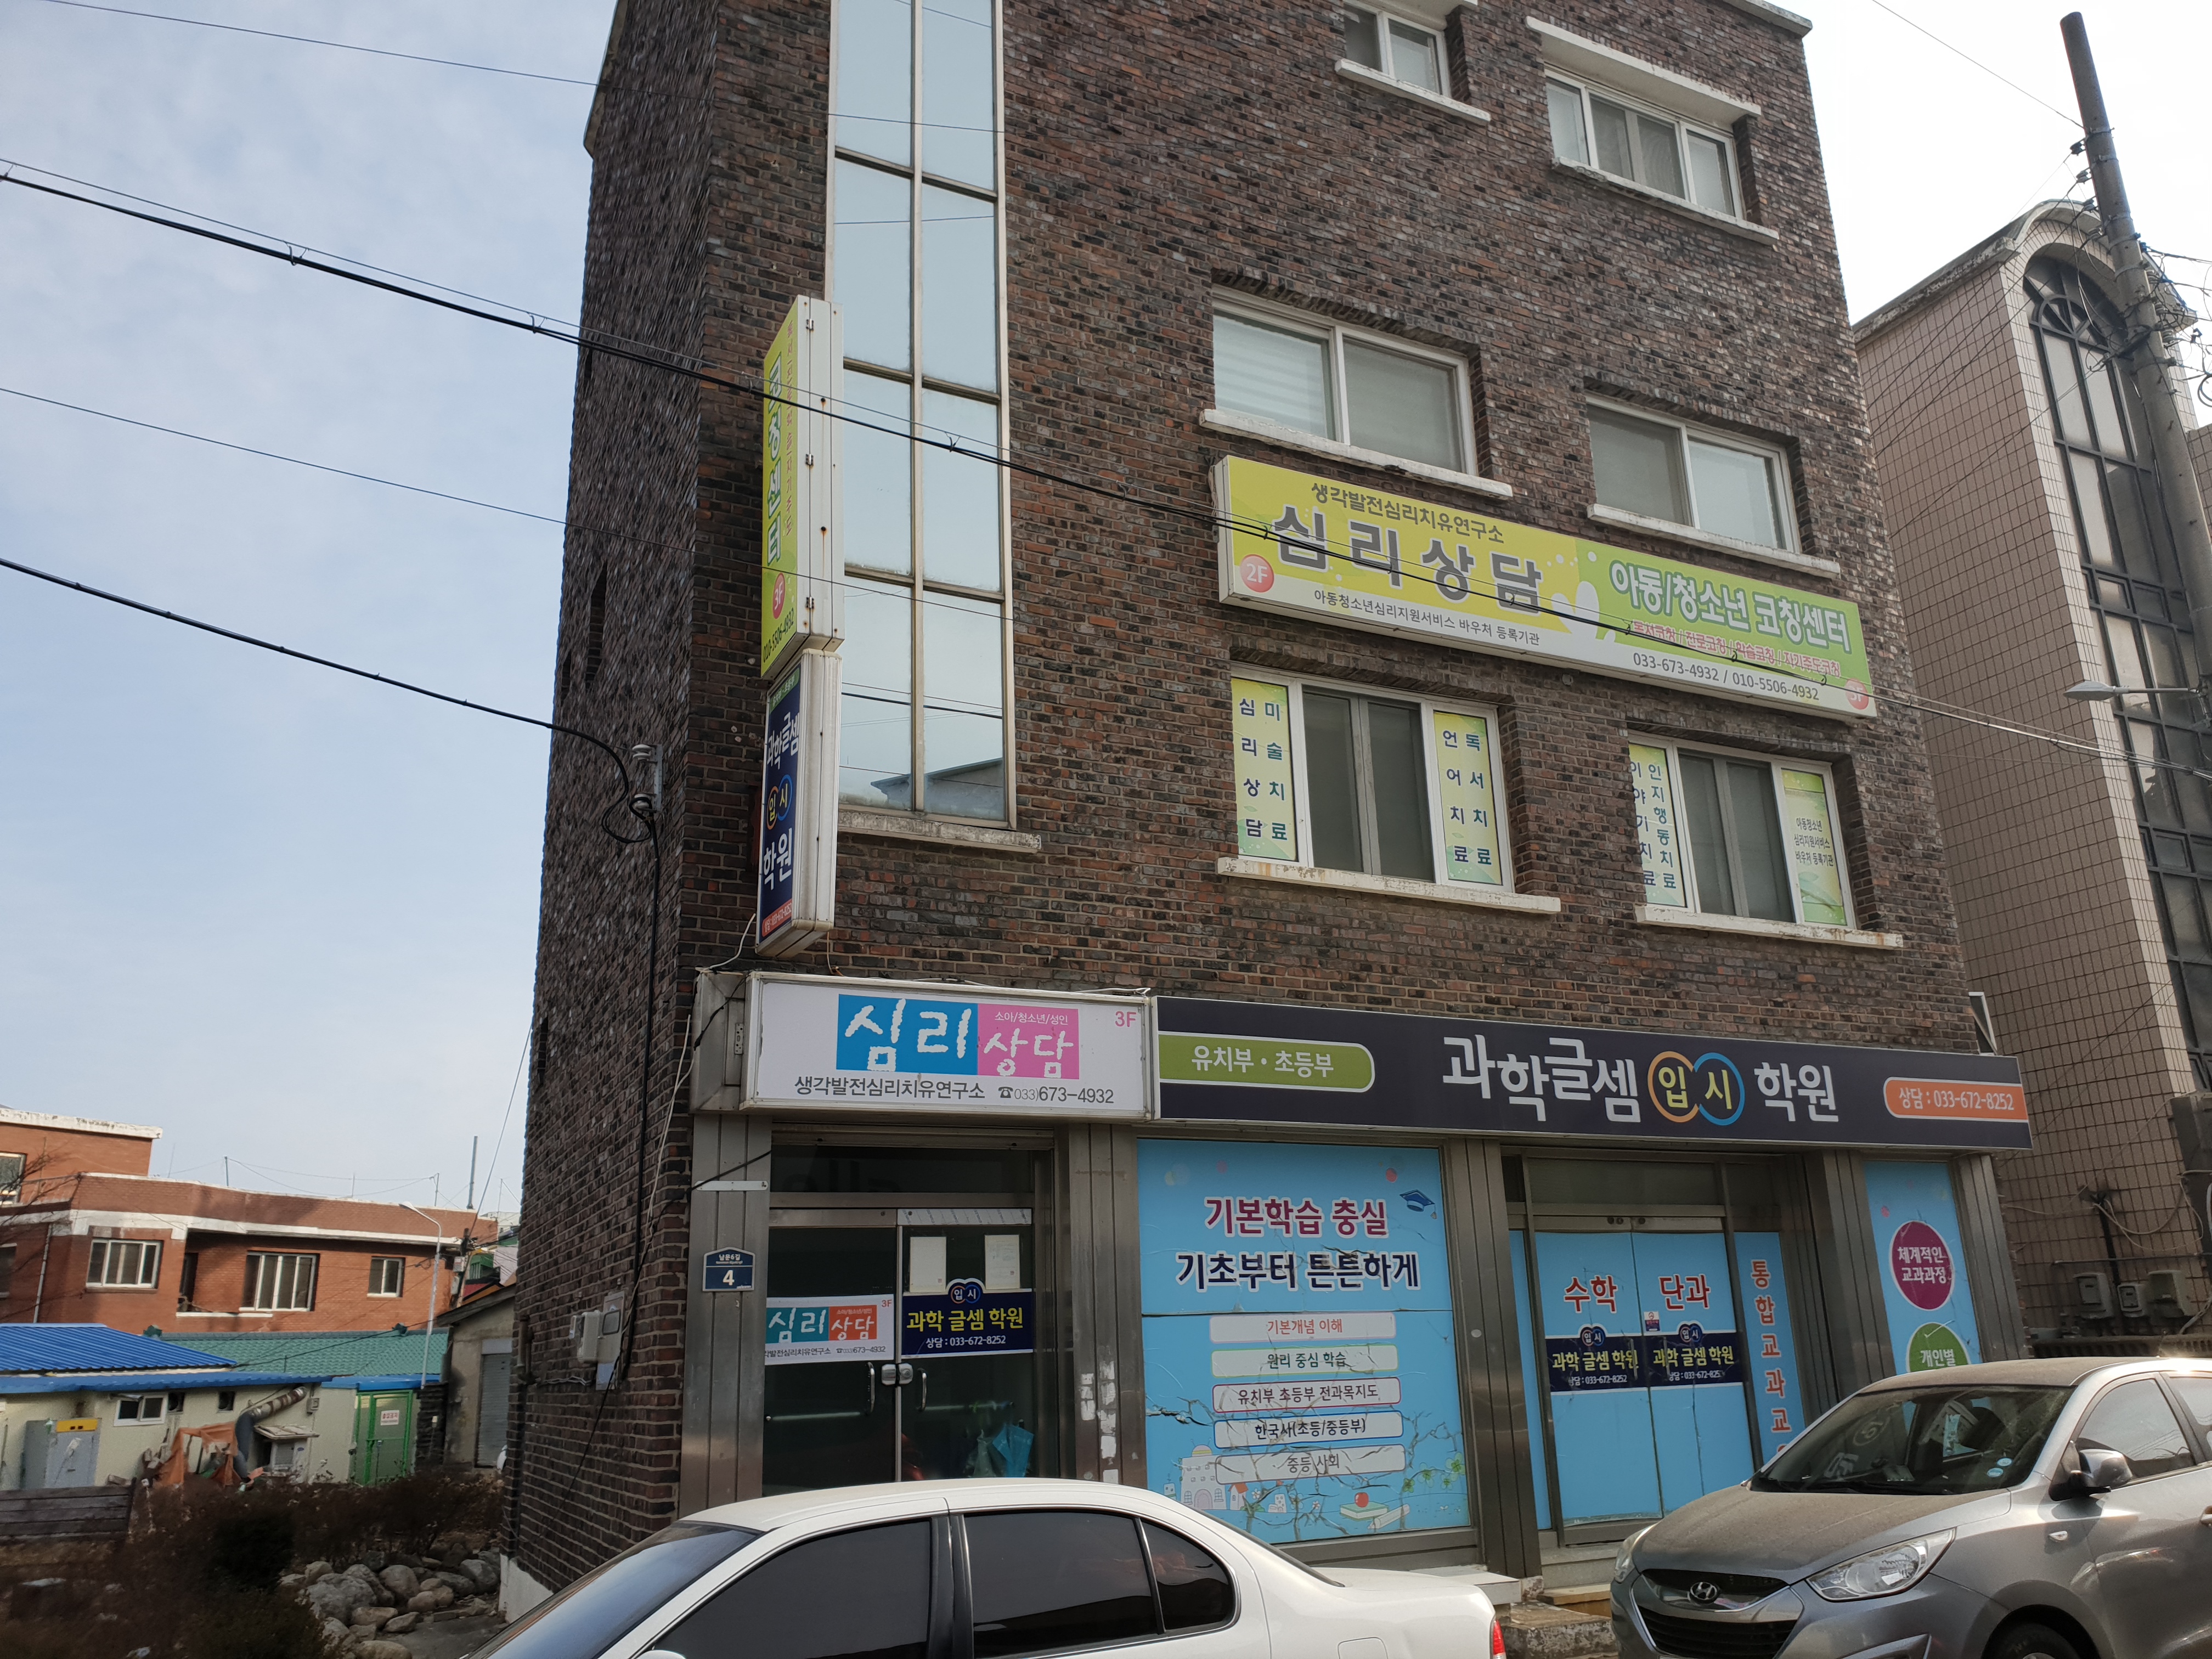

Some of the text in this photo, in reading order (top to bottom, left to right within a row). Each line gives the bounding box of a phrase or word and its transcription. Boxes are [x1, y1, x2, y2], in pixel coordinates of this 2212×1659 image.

[1311, 482, 1504, 544] 생각발전심리치유연구소
[1246, 562, 1268, 584] 2F
[774, 581, 783, 610] 3F
[1610, 561, 1852, 653] 아동/청소년 코칭센터
[1314, 590, 1540, 646] 아동청소년심리지원서비스 바우처 등록기관
[763, 607, 794, 663] 010-5506-4932
[1633, 652, 1719, 681] 033-673-4932
[1733, 673, 1819, 701] 010-5506-4932
[767, 712, 799, 769] 과학글셈
[769, 785, 788, 822] 입시
[763, 827, 792, 891] 학원
[994, 1011, 1069, 1026] 소아/청소년/성인
[1115, 1011, 1137, 1028] 3F
[845, 998, 1073, 1079] 심리 상담
[1191, 1045, 1254, 1074] 유치부
[1274, 1051, 1334, 1077] 초등부
[794, 1076, 985, 1099] 생각발전심리치유연구소
[1443, 1034, 1839, 1122] 과학글셈 입시 학원
[1933, 1090, 2015, 1110] 033-672-8252
[1206, 1197, 1389, 1236] 기본학습 충실
[1898, 1246, 1944, 1263] 체계적인
[723, 1269, 735, 1285] 4
[1177, 1253, 1420, 1290] 기초부터 튼튼하게
[1901, 1267, 1946, 1284] 교과과정
[954, 1289, 976, 1300] 입시
[1564, 1274, 1711, 1313] 수학 단과
[769, 1307, 874, 1344] 심리 상담
[907, 1307, 1023, 1332] 과학 글셈 학원
[1267, 1317, 1343, 1335] 기본개념 이해
[950, 1335, 1006, 1346] 033-672-8252
[1267, 1351, 1346, 1369] 원리 중심 학습
[1553, 1352, 1579, 1371] 과학
[1582, 1351, 1610, 1370] 글셈
[1654, 1346, 1734, 1367] 과학 글셈 학원
[1751, 1259, 1791, 1452] 통합교과교
[1921, 1349, 1955, 1367] 개인별
[1585, 1375, 1627, 1384] 033-672-8252
[1238, 1384, 1379, 1404] 유치부 초등부 전과목지도
[1288, 1454, 1339, 1473] 중등 사회
